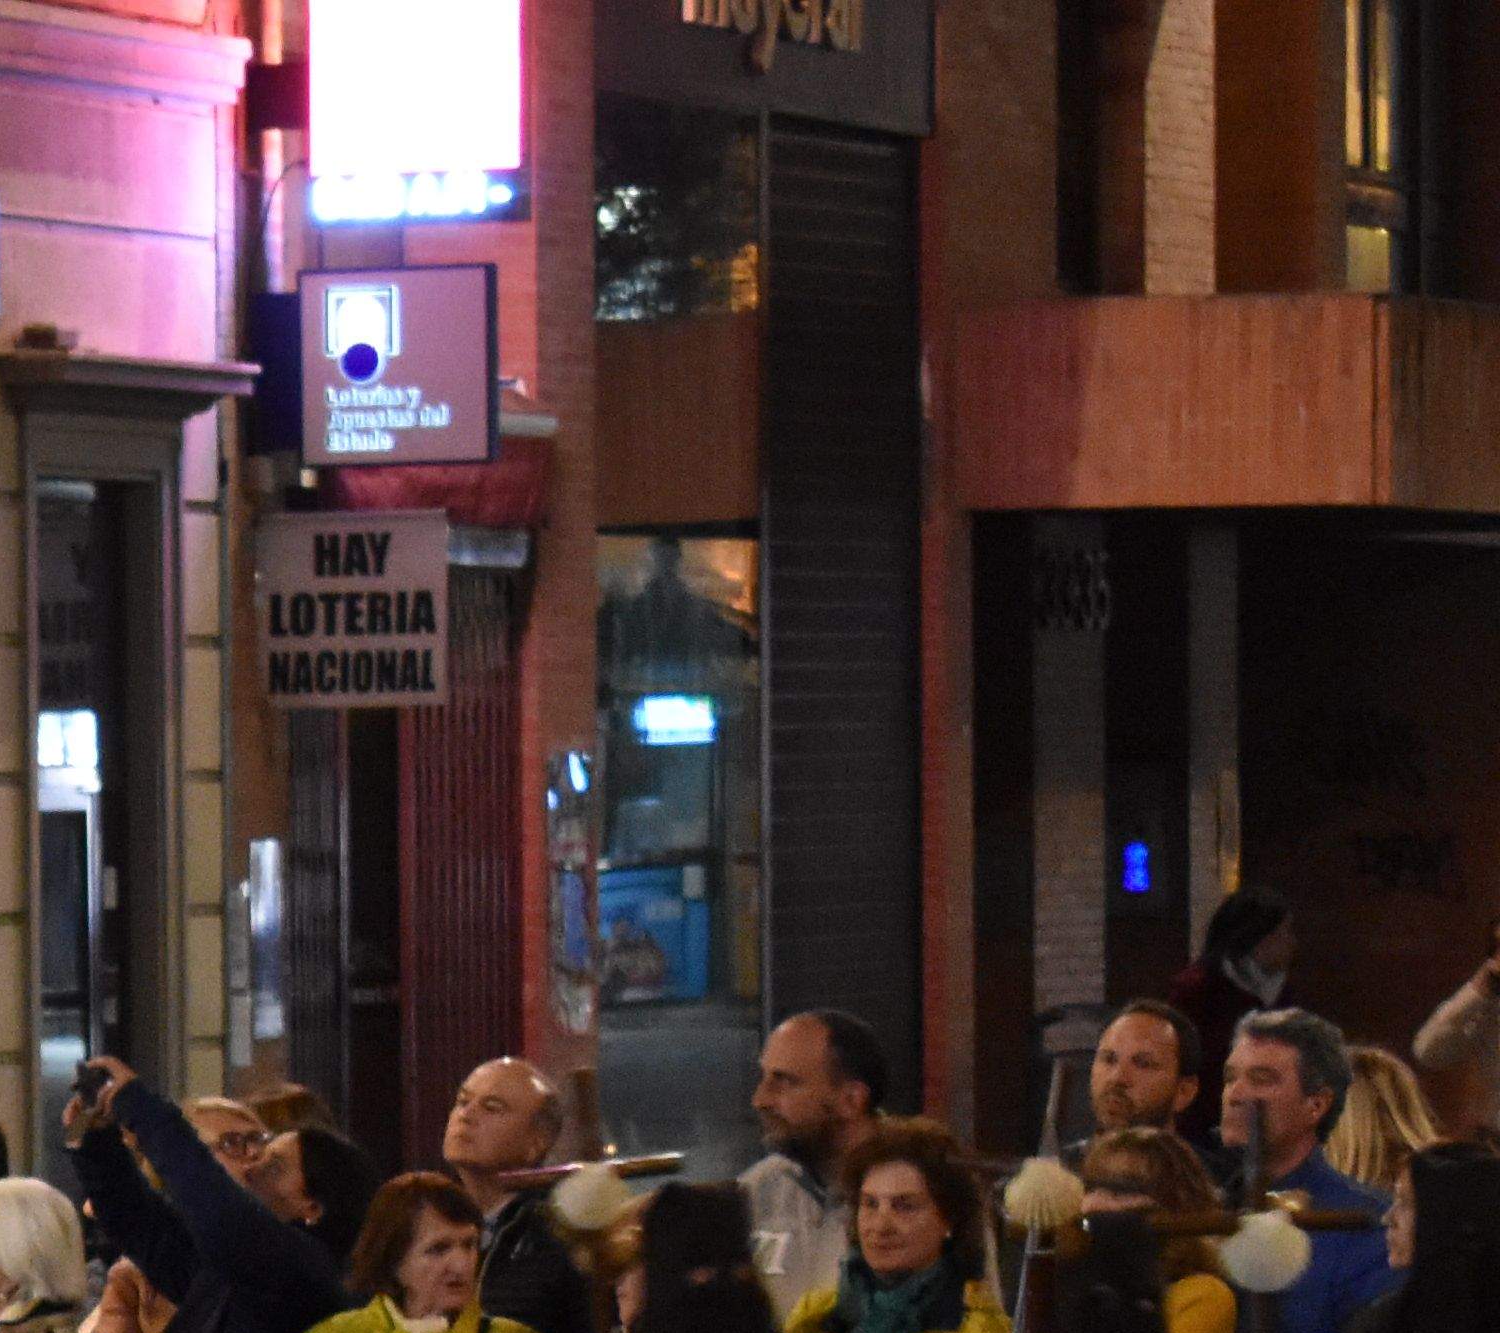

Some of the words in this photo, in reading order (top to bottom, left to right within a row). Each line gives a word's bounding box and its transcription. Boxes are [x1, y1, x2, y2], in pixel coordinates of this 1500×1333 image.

[313, 532, 392, 578] HAY
[269, 588, 436, 637] LOTERIA
[268, 649, 437, 694] NACIONAL
